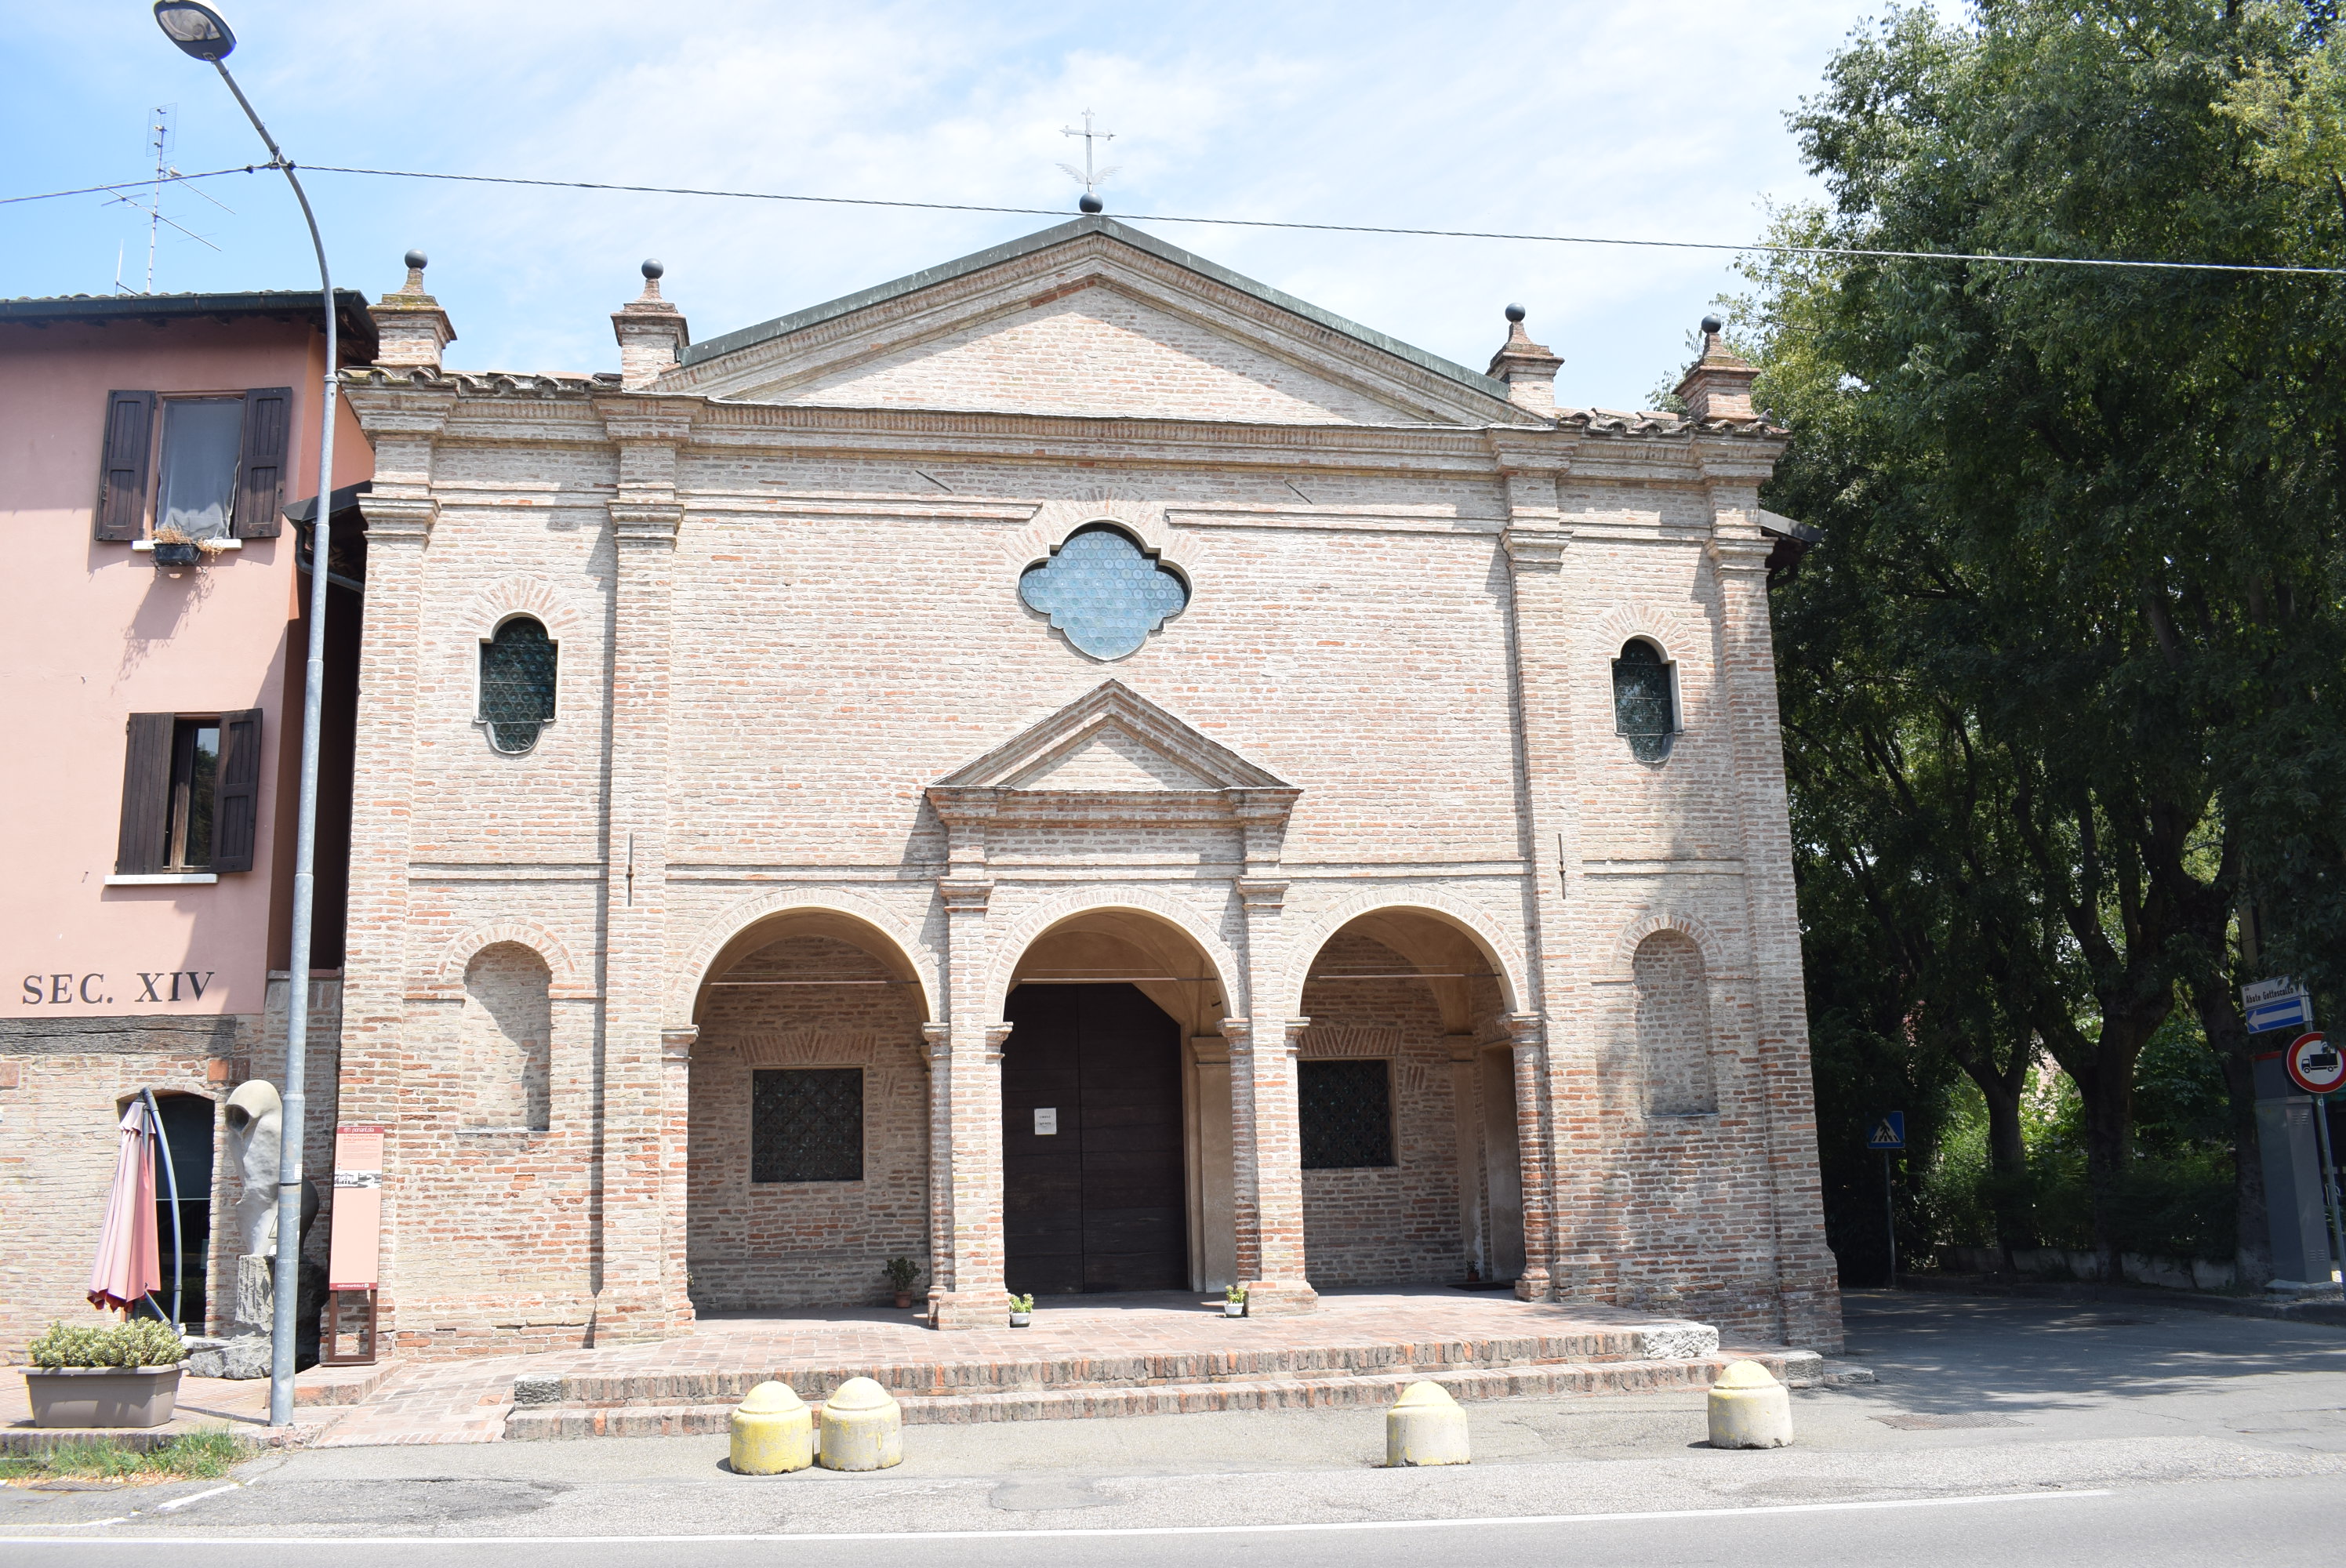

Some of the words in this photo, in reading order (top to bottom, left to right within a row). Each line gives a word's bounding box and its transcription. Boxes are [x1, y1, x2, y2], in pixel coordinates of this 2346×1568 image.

[22, 973, 114, 1004] SEC.
[135, 971, 215, 1003] XIV
[2246, 994, 2261, 1004] Abate
